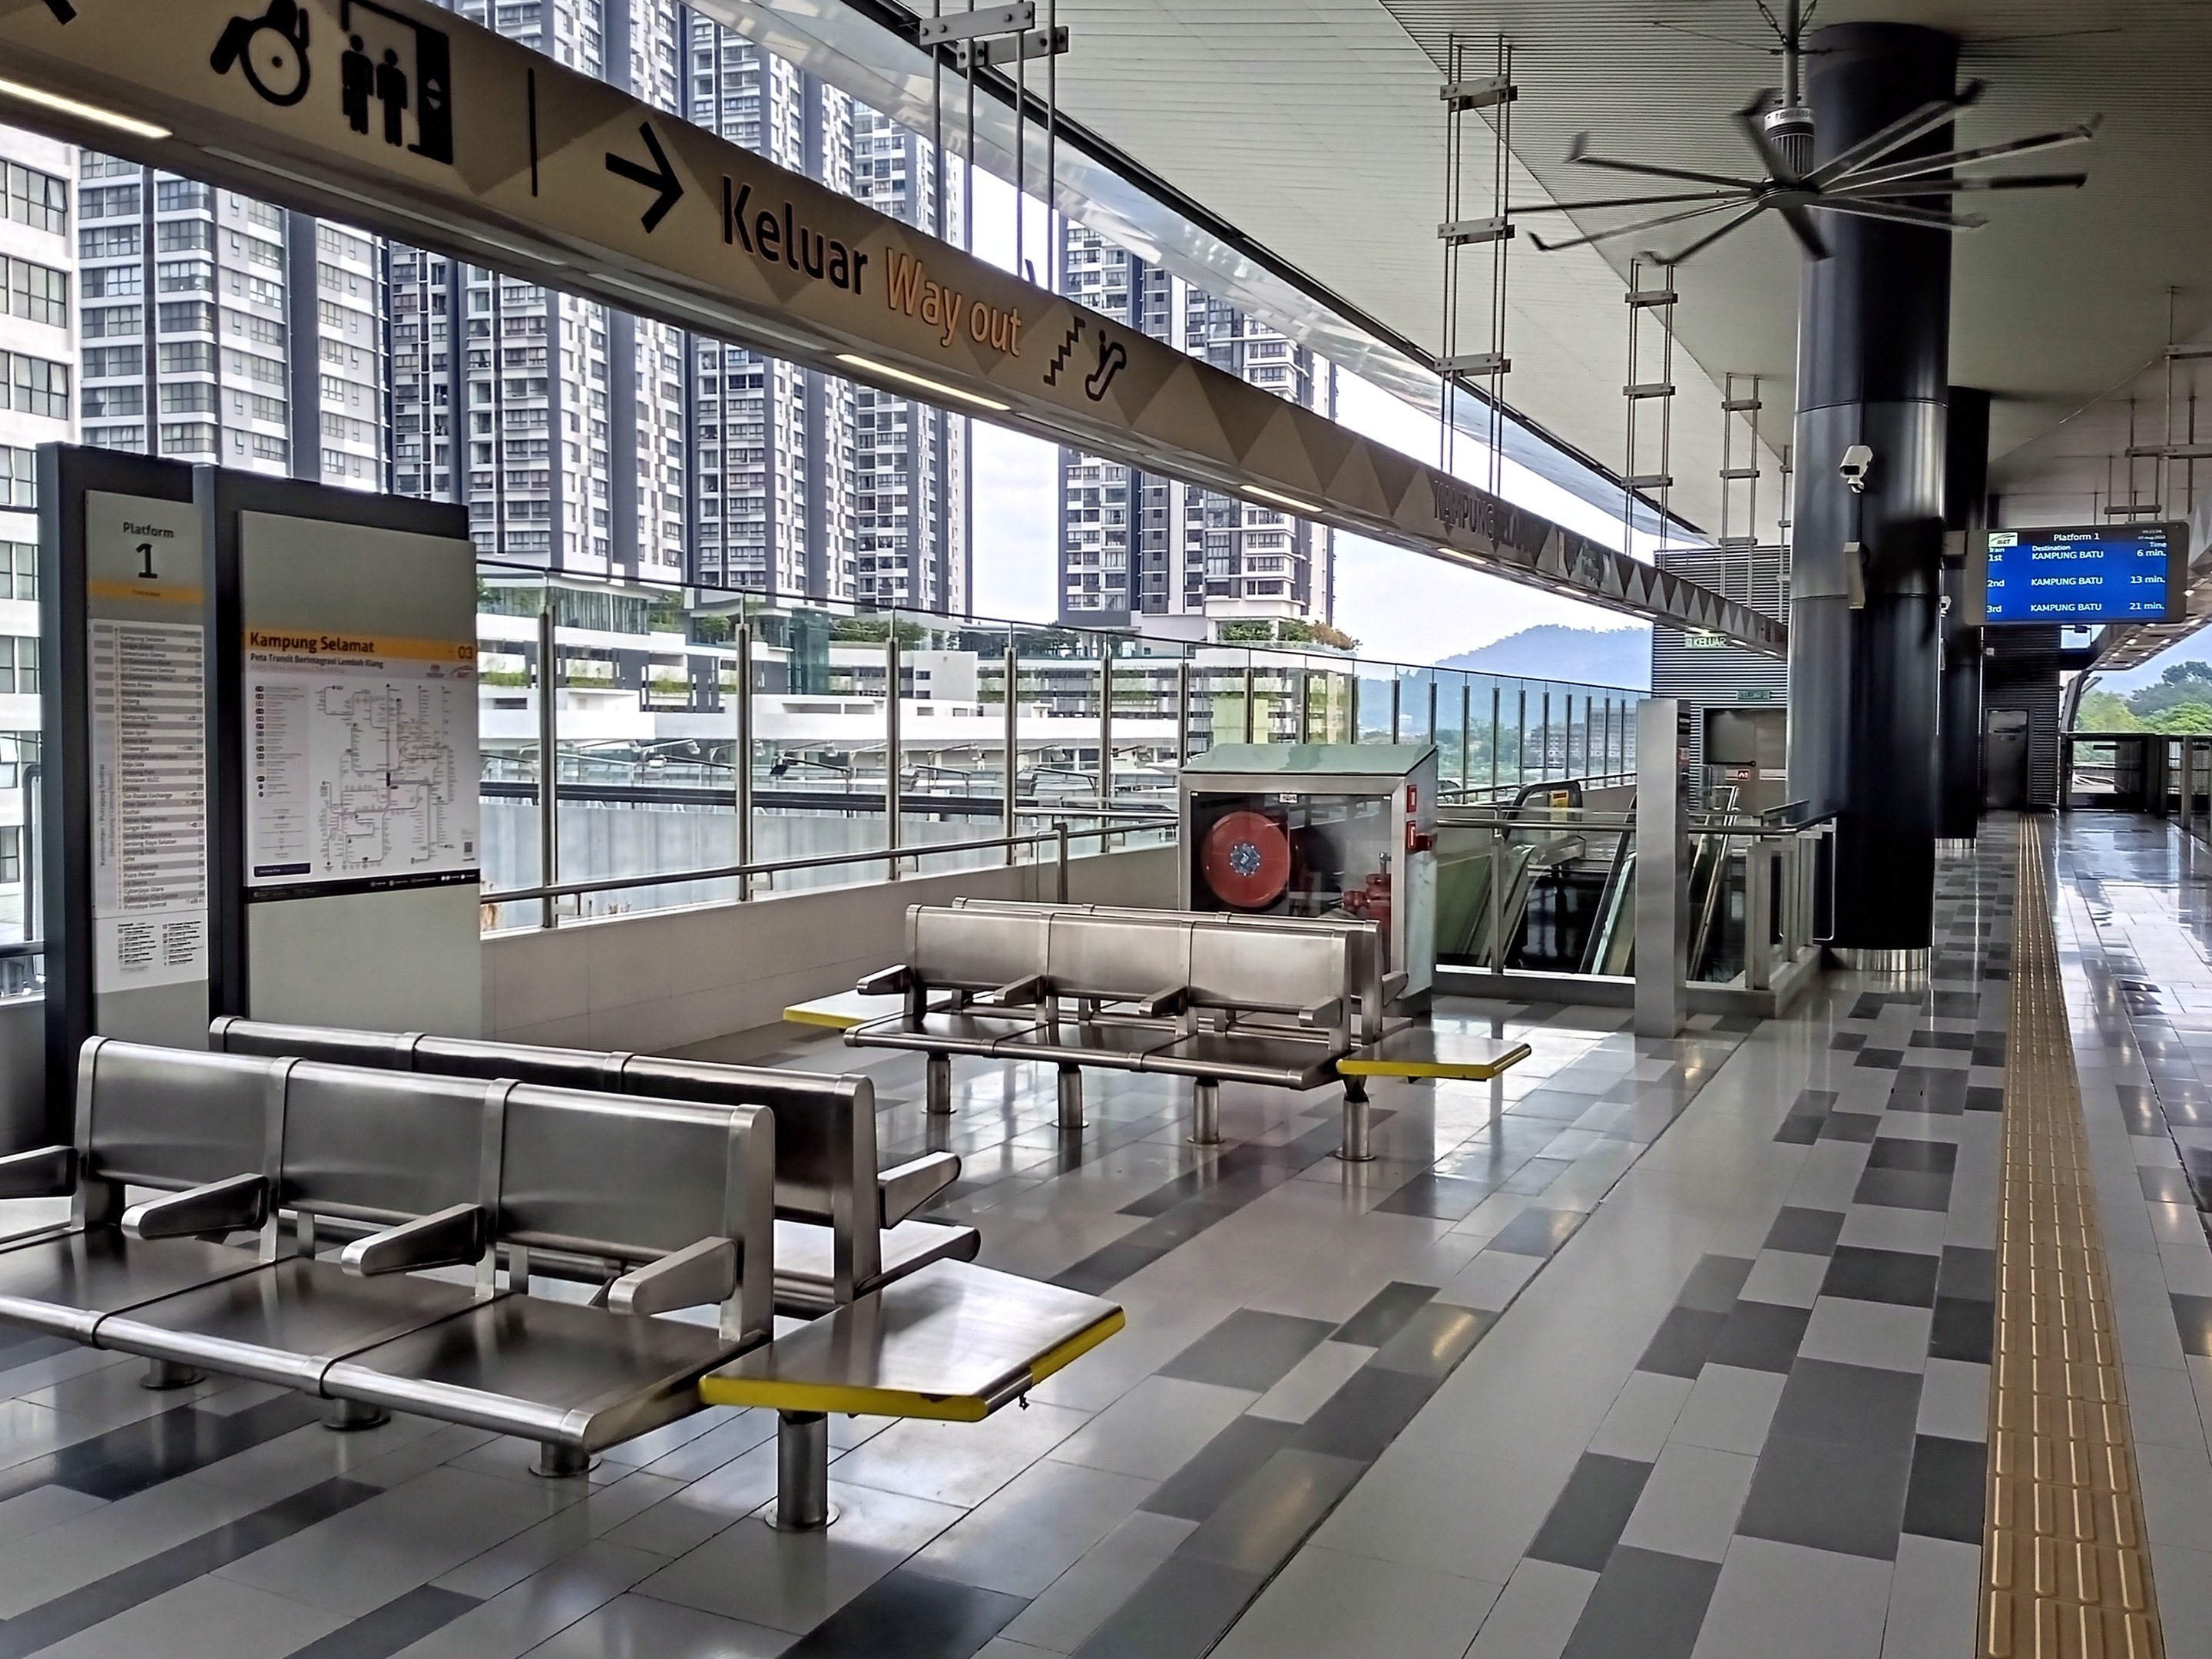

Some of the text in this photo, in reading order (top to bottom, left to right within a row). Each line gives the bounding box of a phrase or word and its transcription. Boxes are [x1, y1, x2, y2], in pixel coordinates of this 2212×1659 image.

[722, 174, 1022, 357] Keluar Way out
[1434, 480, 1494, 541] KAMPUNG
[123, 522, 174, 538] Platform
[2054, 532, 2100, 542] Platform 1
[135, 543, 158, 579] 1
[2032, 551, 2078, 560] KAMPUNG
[2079, 550, 2104, 559] BATU
[2145, 548, 2167, 557] min.
[1987, 575, 2166, 588] 2nd KAMPUNG BATU 13 min.
[1986, 601, 2164, 613] 3rd KAMPUNG BATU 21 min.
[250, 631, 473, 659] Kampung Selamat 03
[1694, 637, 1727, 647] KELUAR
[269, 654, 293, 663] Transit
[294, 655, 337, 667] Berintegrasi
[338, 657, 364, 666] Lembah
[365, 659, 384, 669] Klang
